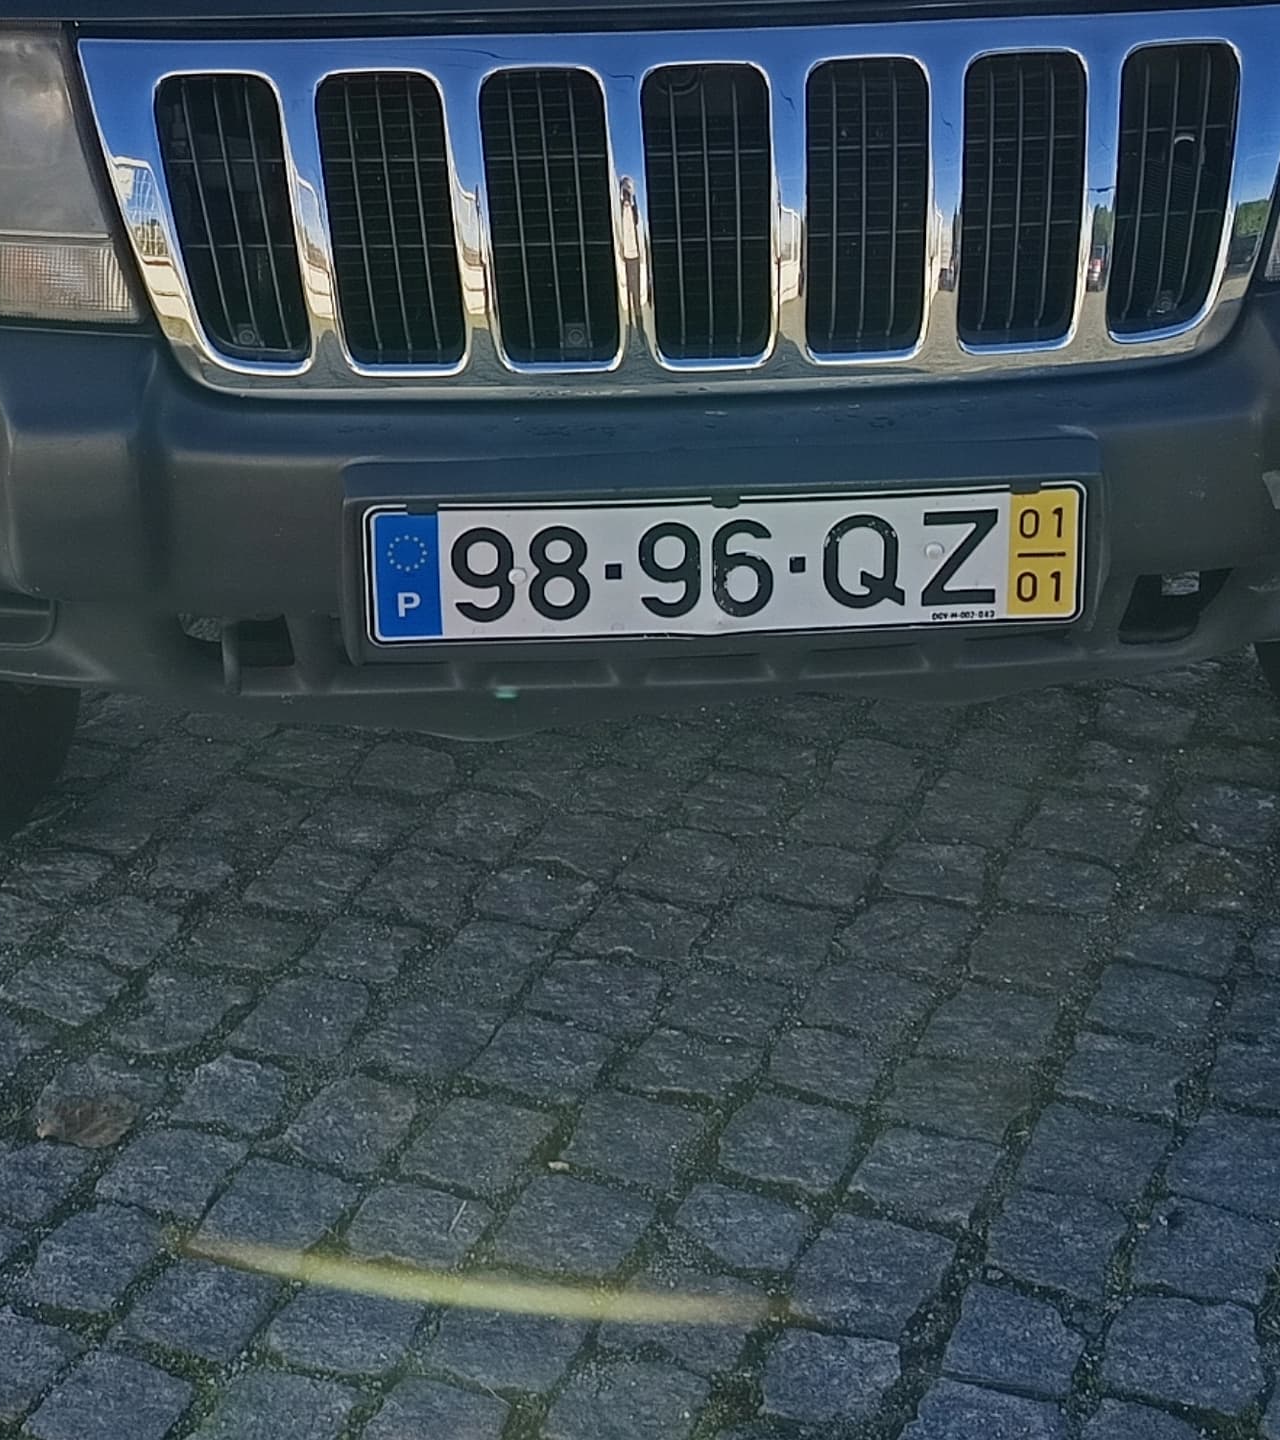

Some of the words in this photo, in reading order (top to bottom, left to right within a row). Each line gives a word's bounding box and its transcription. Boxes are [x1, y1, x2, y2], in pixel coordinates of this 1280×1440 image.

[1018, 507, 1066, 541] 01
[1015, 569, 1064, 604] 01
[396, 592, 421, 619] P
